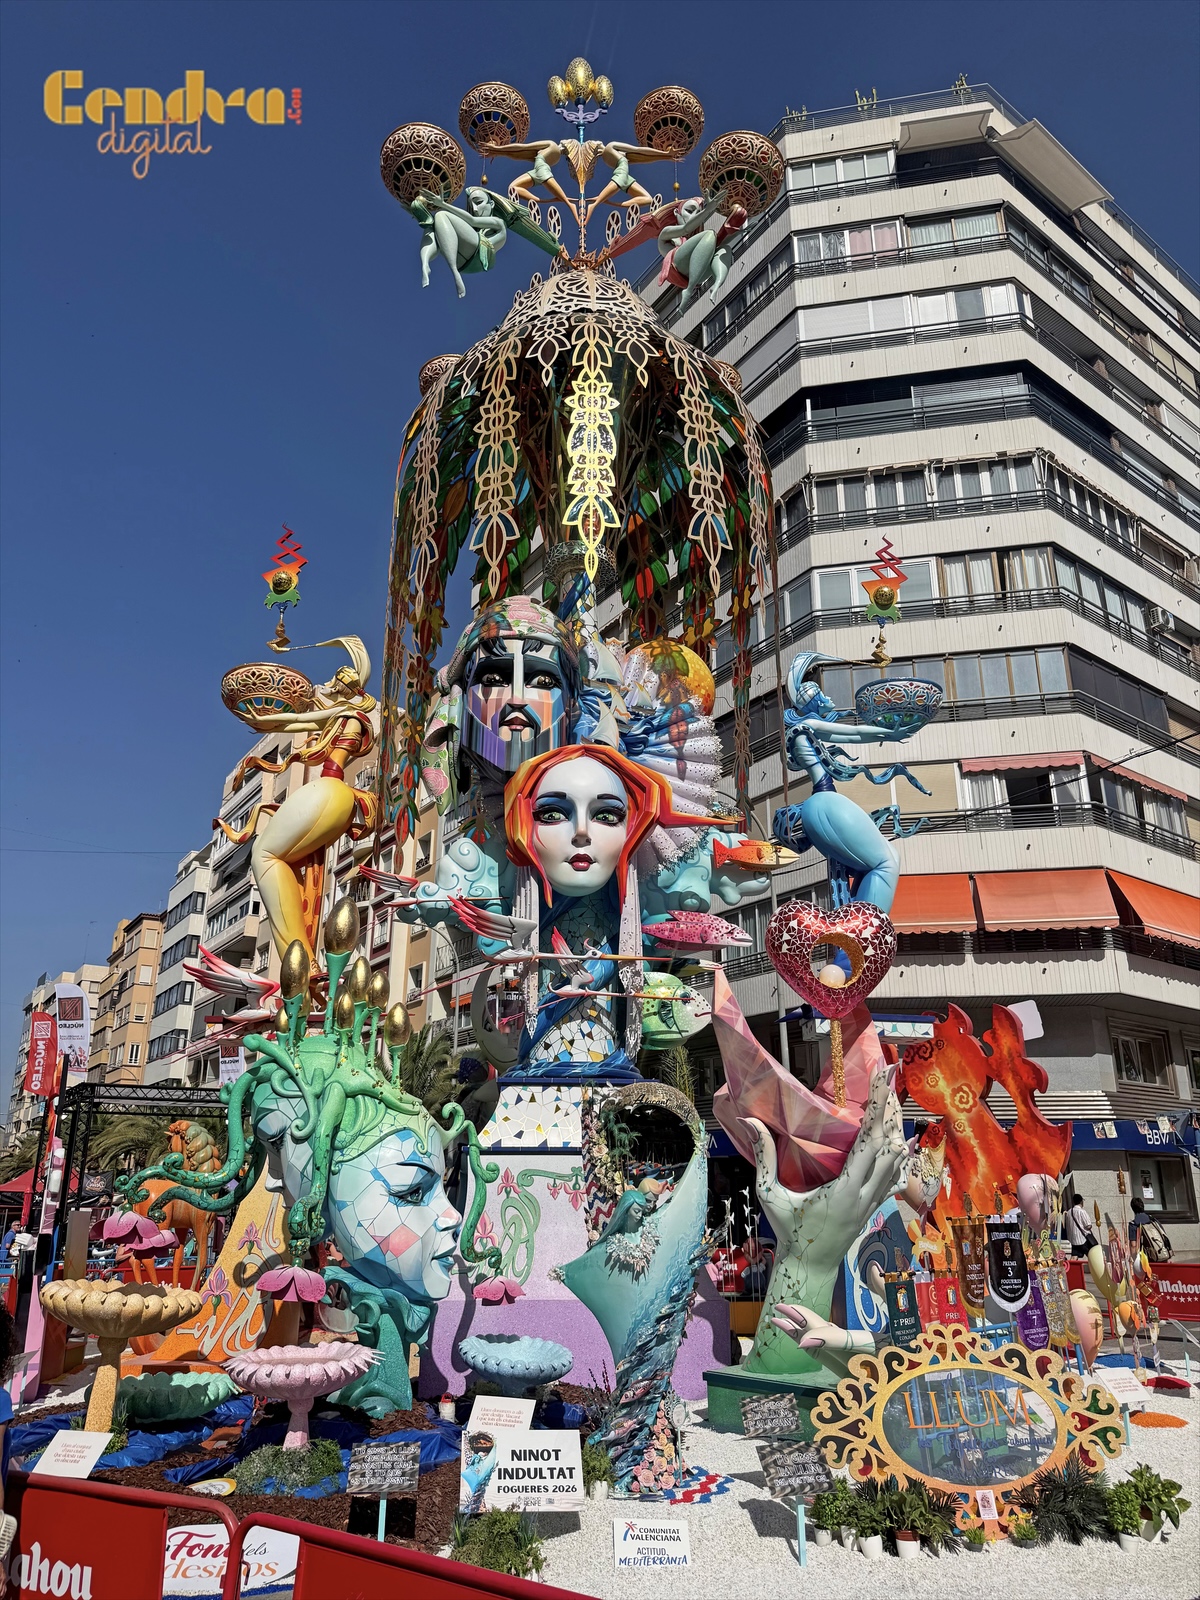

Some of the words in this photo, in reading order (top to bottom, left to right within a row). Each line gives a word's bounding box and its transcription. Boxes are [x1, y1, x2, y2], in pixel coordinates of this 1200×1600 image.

[1007, 1267, 1013, 1277] 3
[1032, 1315, 1037, 1326] 7
[901, 1389, 1033, 1429] LLUM
[511, 1449, 561, 1461] NINOT
[498, 1467, 575, 1480] INDULTAT
[497, 1485, 549, 1493] FOGUERES
[552, 1485, 577, 1493] 2026
[630, 1534, 681, 1542] VALENCIANA
[619, 1555, 688, 1567] MEDITERRÀNIA
[11, 1541, 93, 1600] ahou
[163, 1558, 279, 1579] desios
